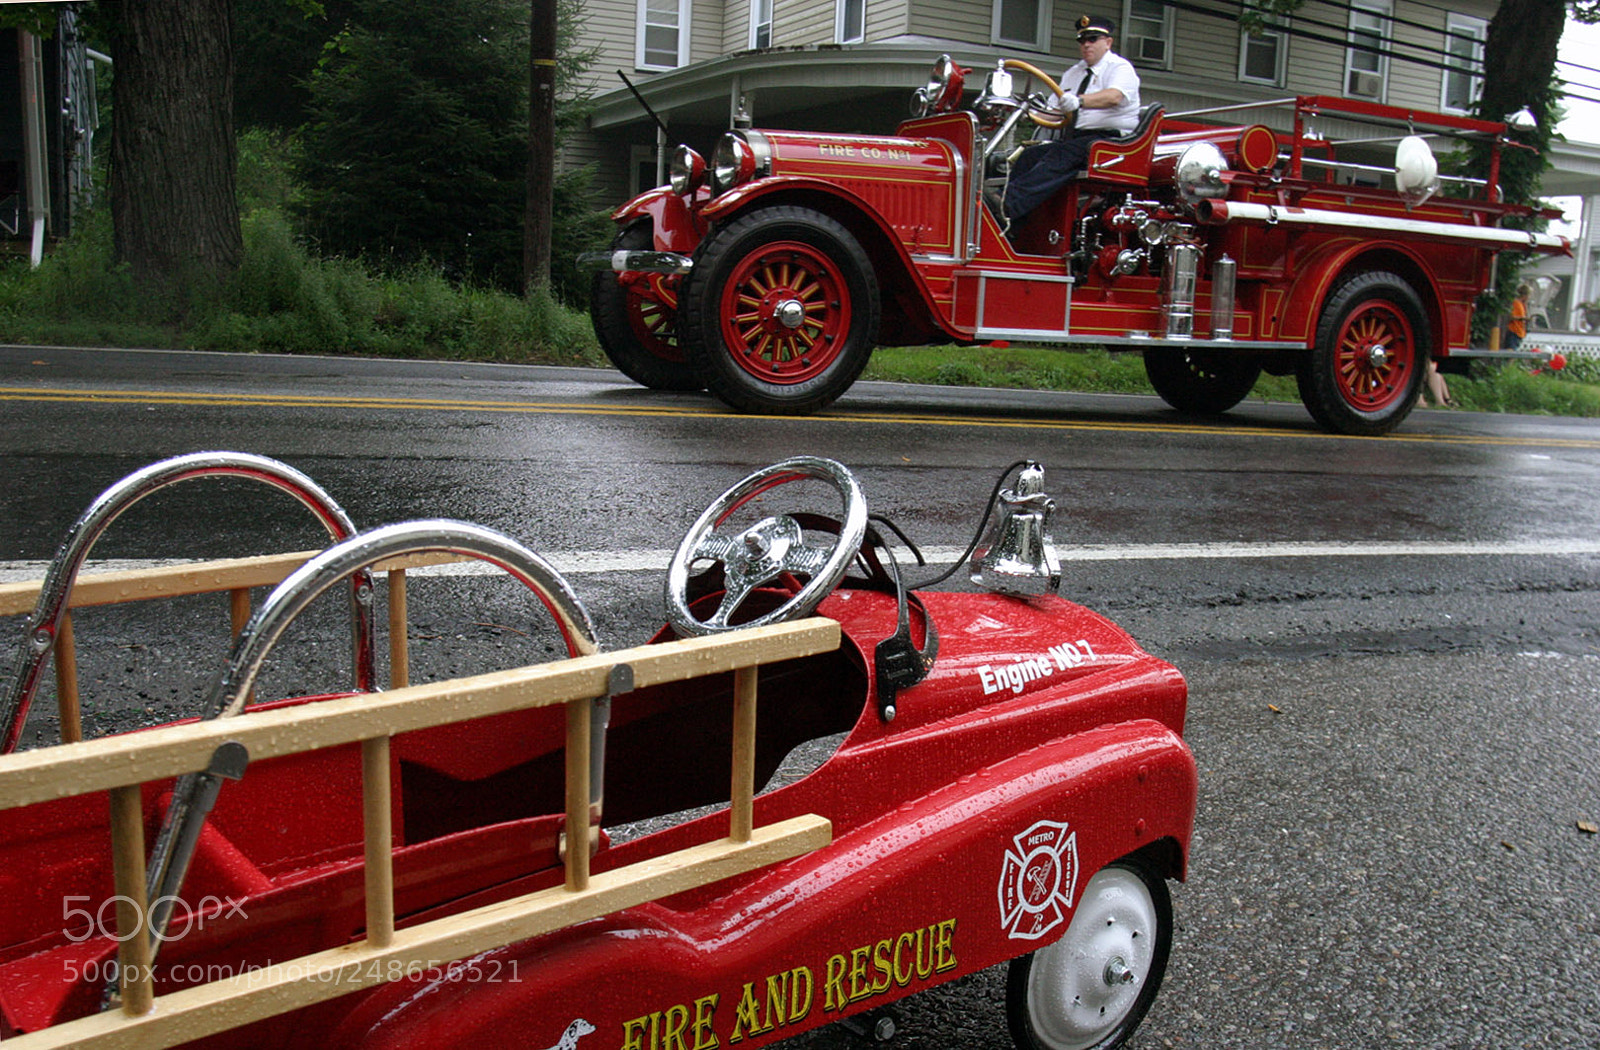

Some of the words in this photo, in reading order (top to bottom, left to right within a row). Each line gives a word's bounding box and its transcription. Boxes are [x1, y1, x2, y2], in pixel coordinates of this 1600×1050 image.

[819, 143, 856, 157] FIRE
[861, 147, 886, 159] CO.
[977, 655, 1054, 695] Engine
[1028, 831, 1055, 846] METRO
[1007, 863, 1015, 910] FIRE
[620, 993, 720, 1050] FIRE
[729, 966, 815, 1043] AND
[823, 918, 958, 1013] RESCUE
